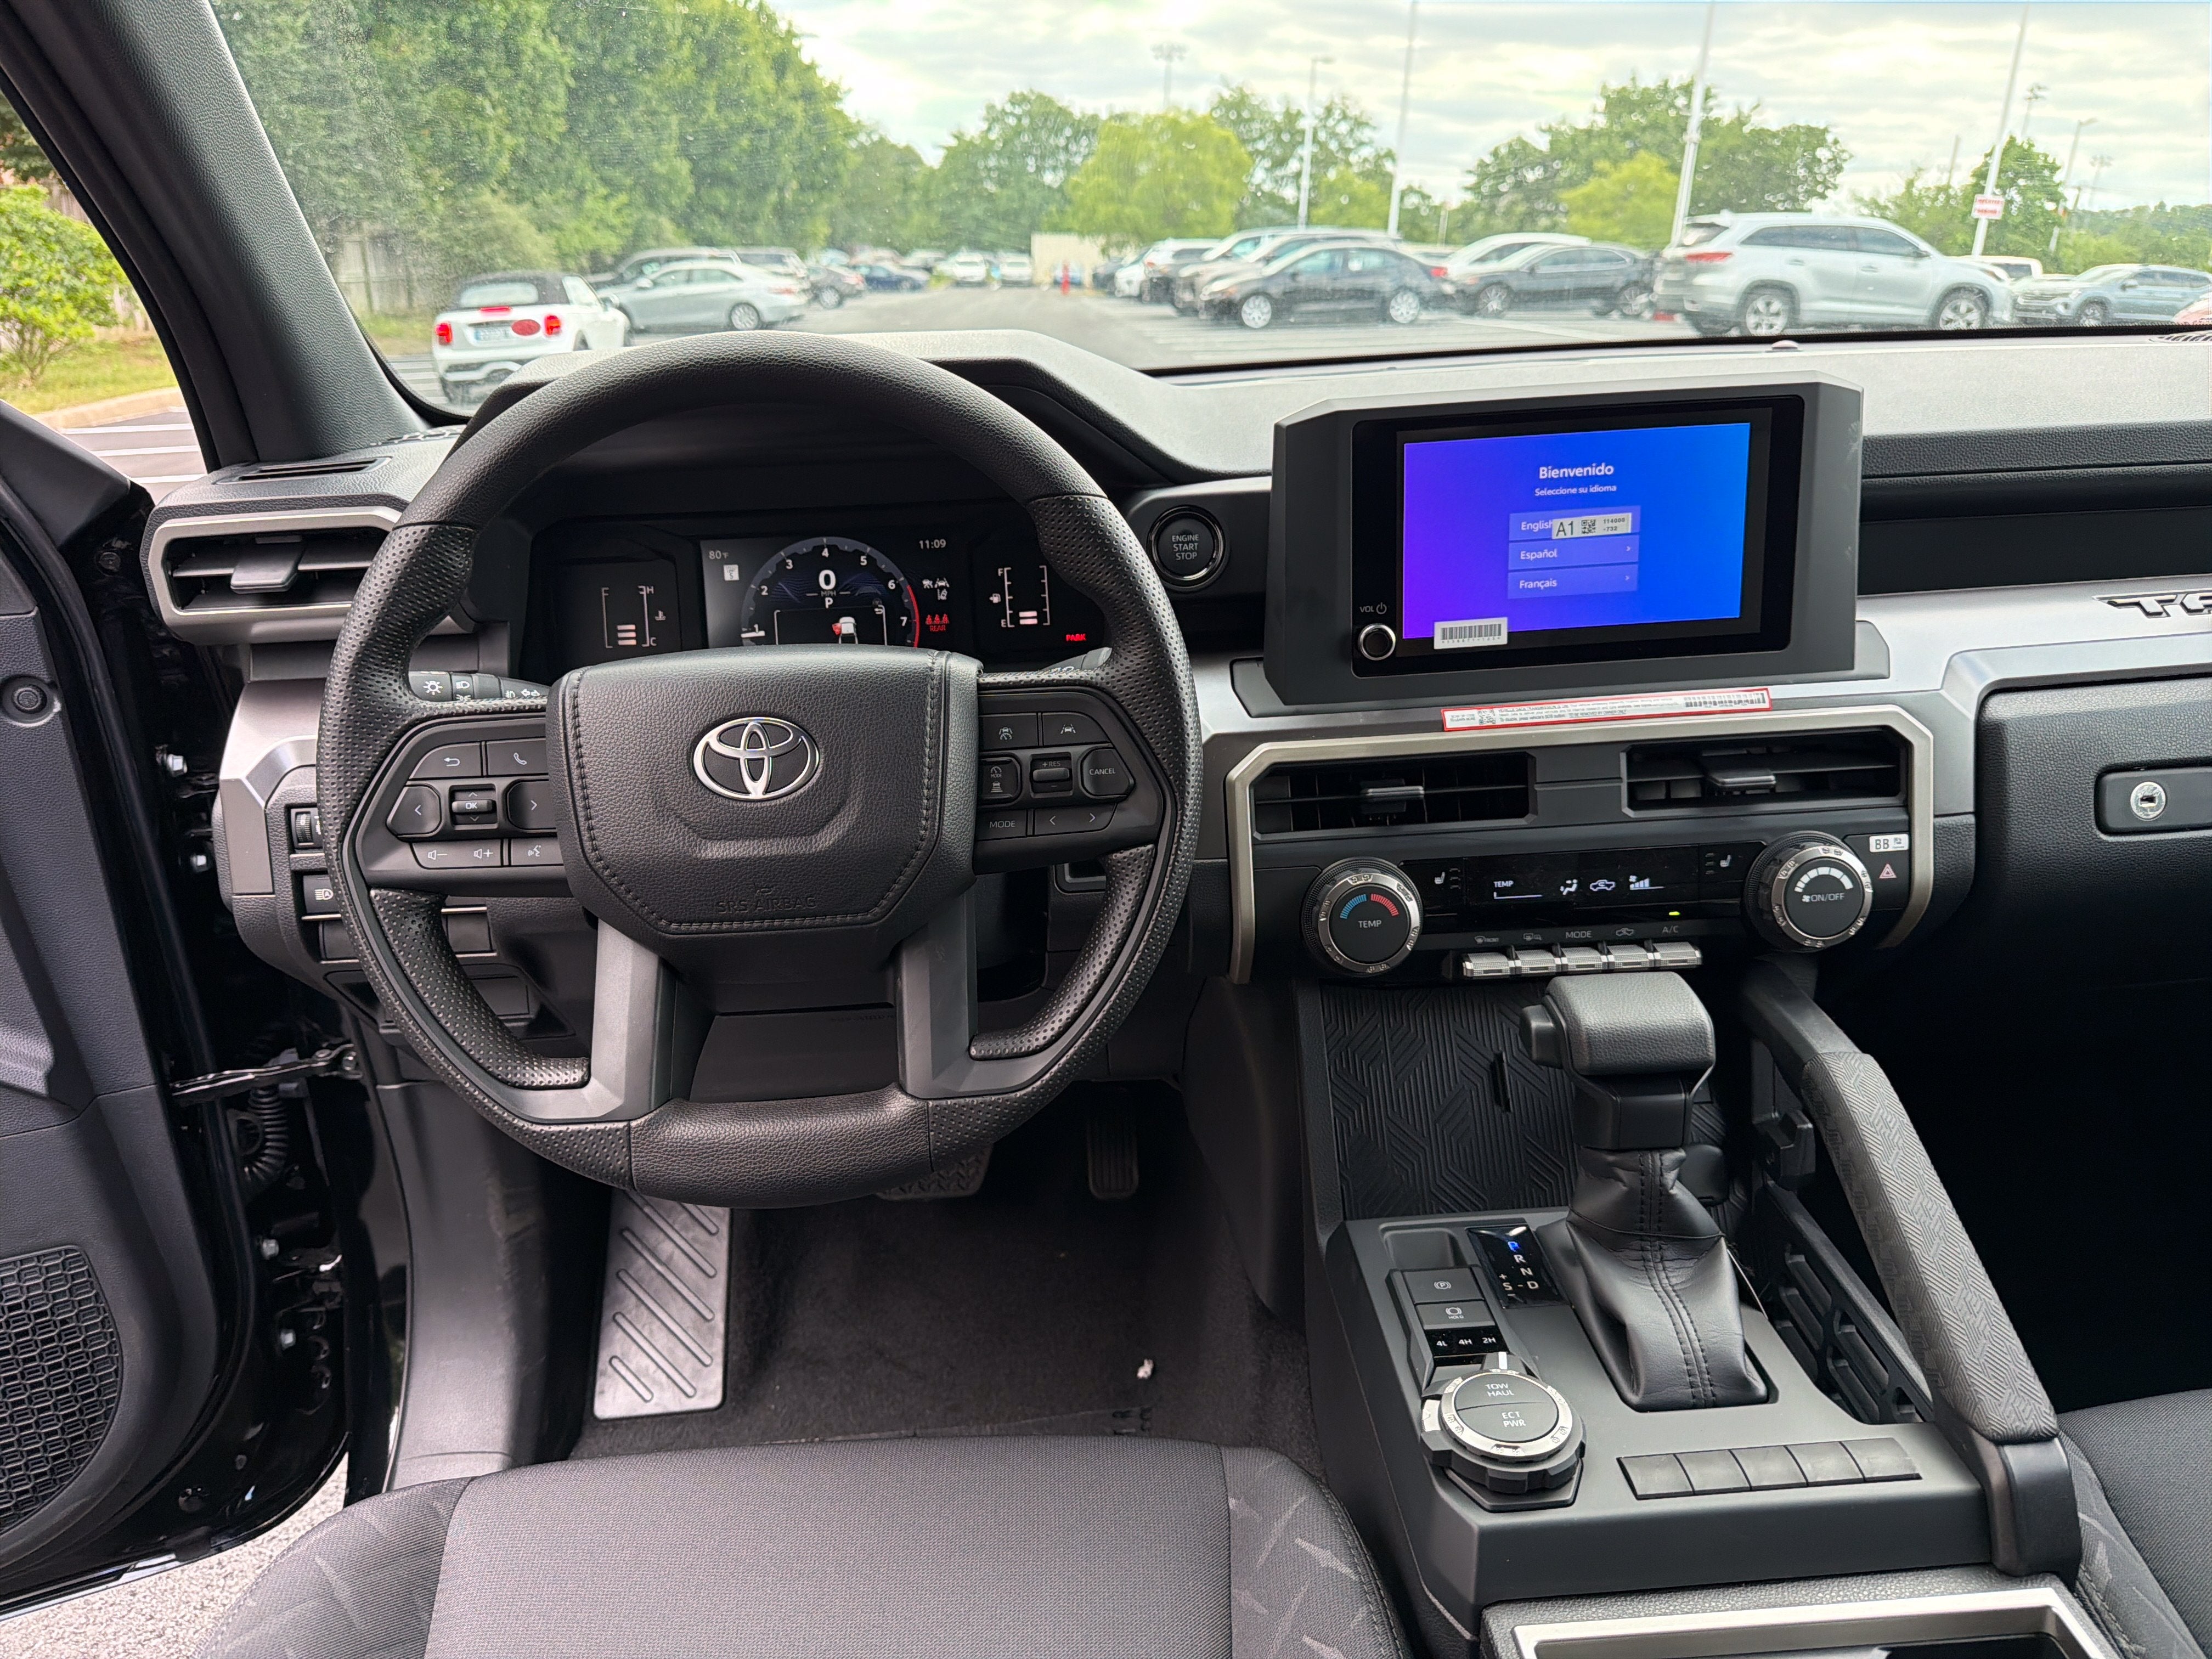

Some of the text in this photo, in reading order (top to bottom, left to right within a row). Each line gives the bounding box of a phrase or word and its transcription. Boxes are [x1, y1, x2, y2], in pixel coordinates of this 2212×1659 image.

[1539, 462, 1614, 479] Bienvenido
[1534, 487, 1578, 496] Seleccione
[1589, 485, 1617, 493] idioma
[1521, 520, 1553, 532] English
[1556, 521, 1574, 537] A1
[919, 539, 946, 549] 11:09
[1173, 543, 1198, 552] START
[821, 548, 829, 557] 4
[1176, 552, 1198, 560] STOP
[1520, 548, 1558, 561] Español
[786, 559, 793, 569] 3
[860, 555, 867, 566] 5
[998, 568, 1003, 576] F
[819, 569, 836, 590] 0
[1519, 578, 1558, 590] Français
[888, 579, 896, 590] 6
[646, 586, 654, 594] H
[760, 585, 768, 595] 2
[821, 587, 837, 596] MPH
[825, 597, 833, 608] P
[900, 617, 907, 627] 7
[1001, 619, 1007, 628] E
[753, 624, 759, 633] 1
[650, 637, 657, 646] C
[989, 820, 1015, 828] MODE
[1875, 838, 1889, 850] BB
[1810, 893, 1845, 902] ON/OFF
[716, 896, 817, 914] SRS AIRBAG
[1358, 920, 1382, 928] TEMP
[1565, 930, 1592, 939] MODE
[1662, 926, 1679, 934] A/C
[1514, 1254, 1527, 1263] R
[1520, 1267, 1533, 1276] N
[1502, 1410, 1520, 1419] ECT
